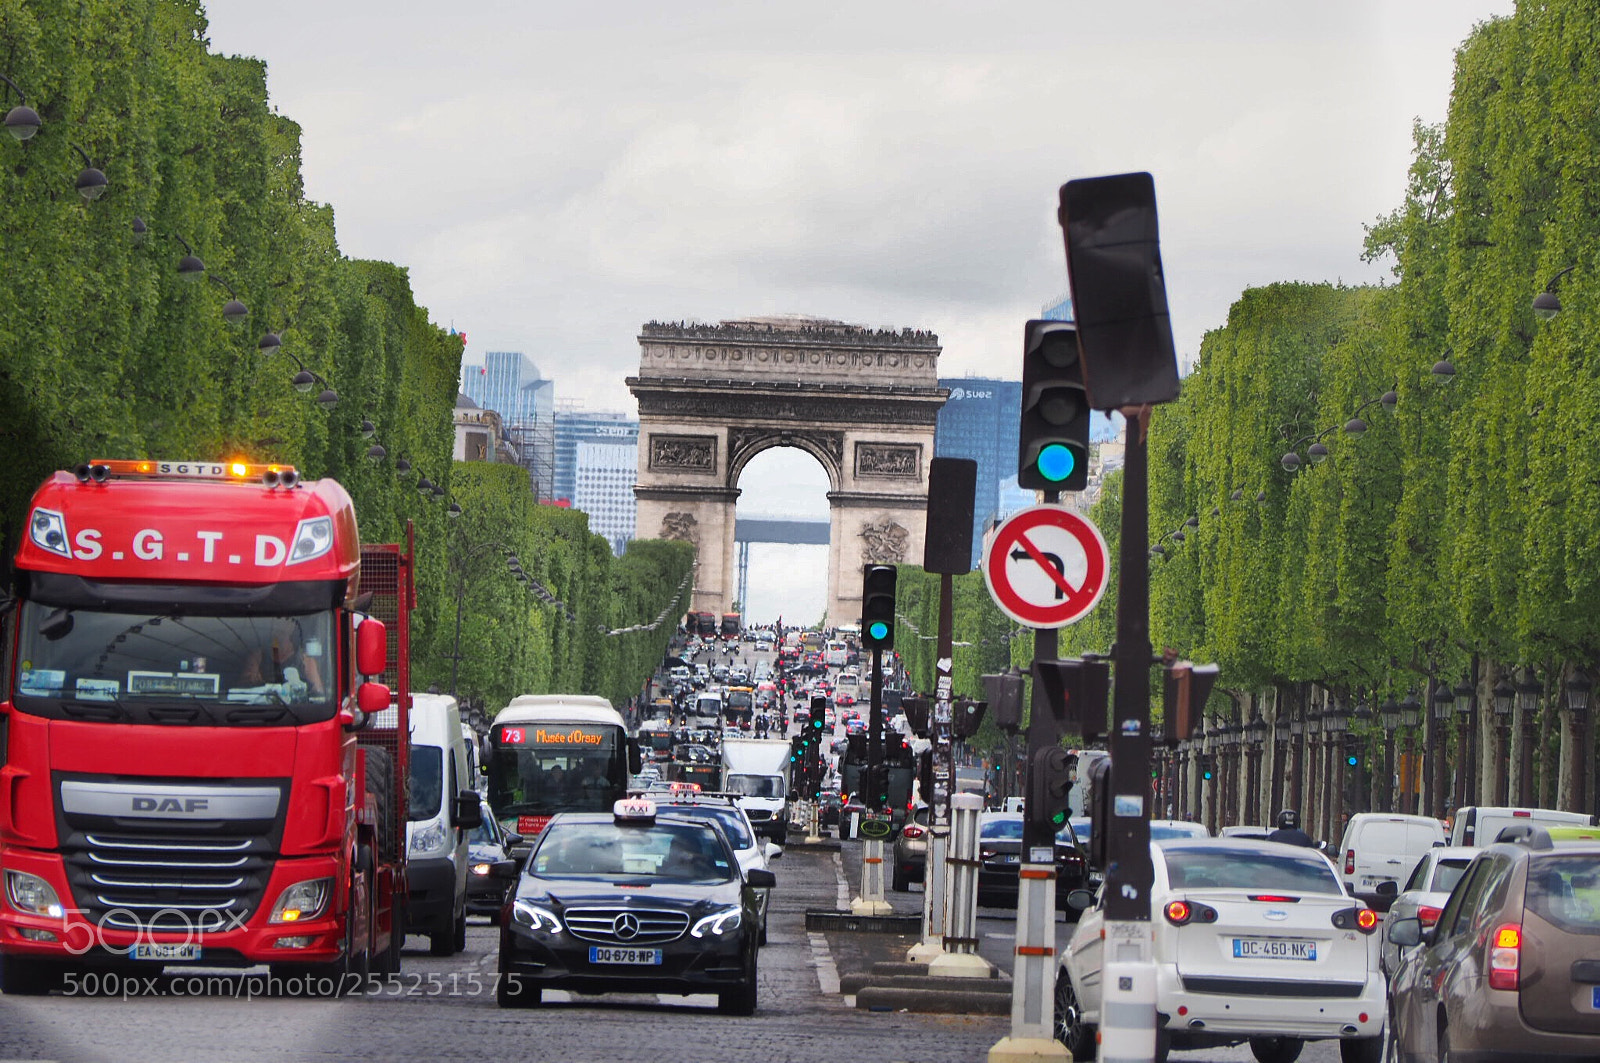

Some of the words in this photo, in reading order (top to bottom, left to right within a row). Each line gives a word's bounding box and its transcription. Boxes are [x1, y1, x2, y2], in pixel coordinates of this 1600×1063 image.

[966, 390, 992, 399] suez
[160, 464, 222, 475] SGTD
[73, 528, 286, 566] S.G.T.D
[505, 729, 520, 743] 73
[536, 729, 565, 743] Musée
[567, 729, 602, 745] d'Orsay
[132, 797, 208, 812] DAF
[597, 949, 653, 963] DQ-678-WP
[1242, 941, 1307, 957] DC-460-NK
